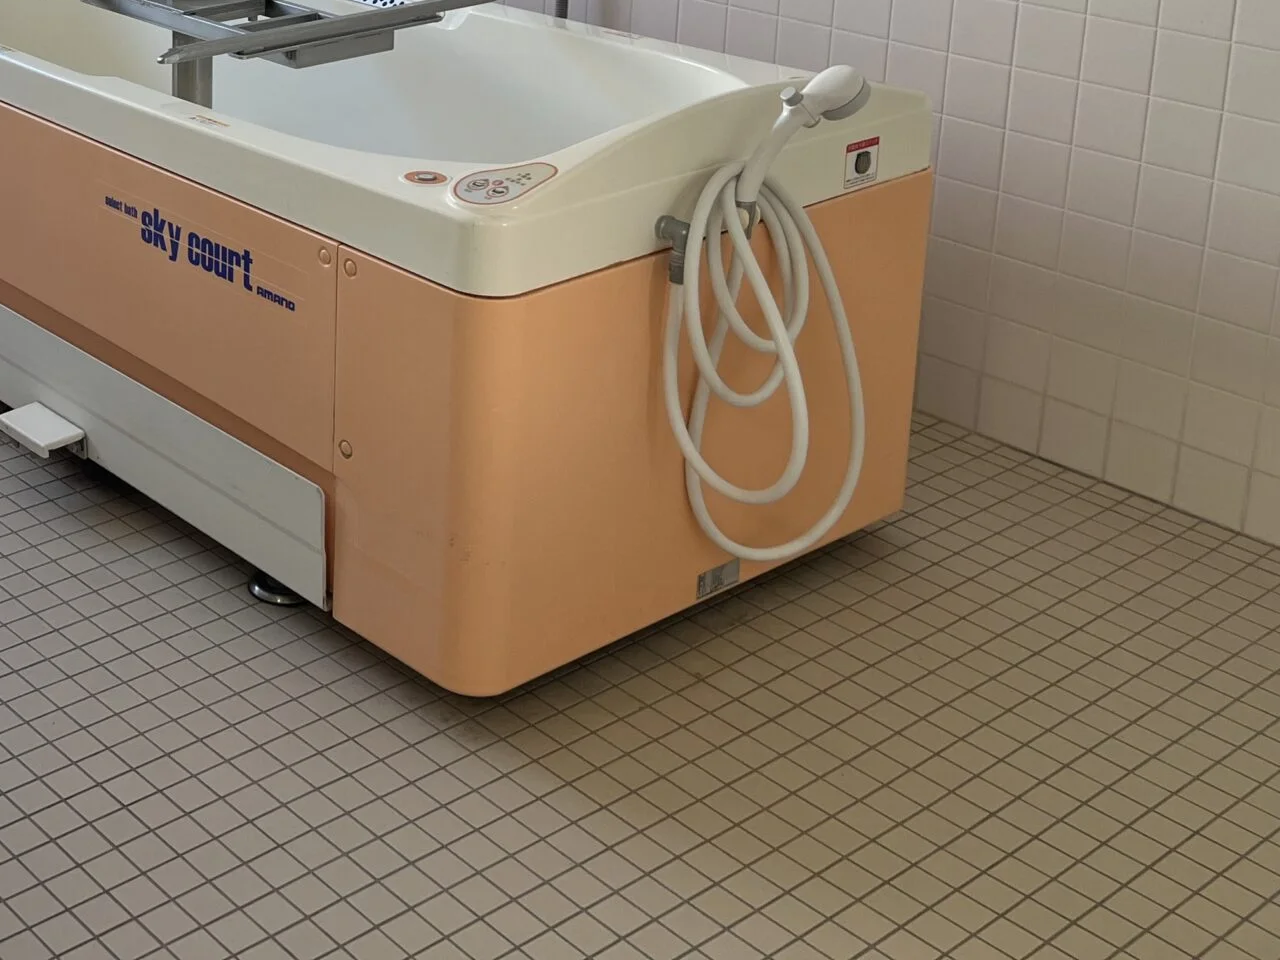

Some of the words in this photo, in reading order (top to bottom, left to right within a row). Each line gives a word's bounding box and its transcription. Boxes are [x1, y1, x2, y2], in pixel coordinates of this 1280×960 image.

[141, 208, 181, 262] sky
[187, 231, 253, 292] court
[256, 286, 296, 312] AMANO
